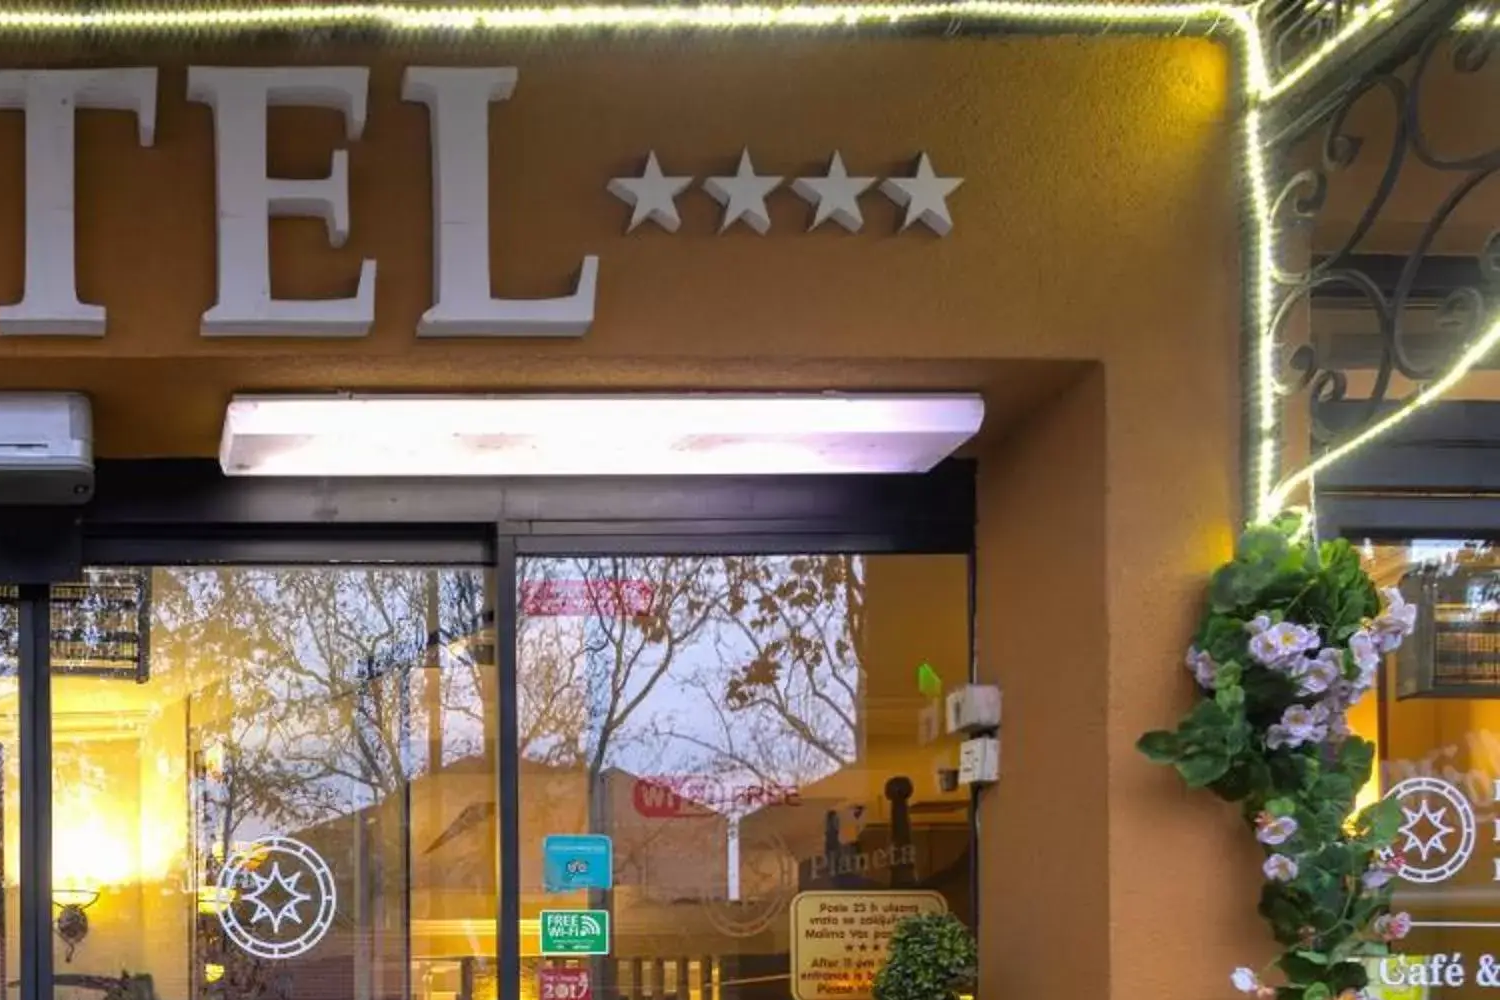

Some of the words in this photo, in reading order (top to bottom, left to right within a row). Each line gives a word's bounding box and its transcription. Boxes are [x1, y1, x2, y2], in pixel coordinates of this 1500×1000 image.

[547, 914, 578, 926] FREE
[547, 926, 579, 937] WI-FI
[1380, 952, 1464, 987] Café
[544, 976, 588, 999] 2017
